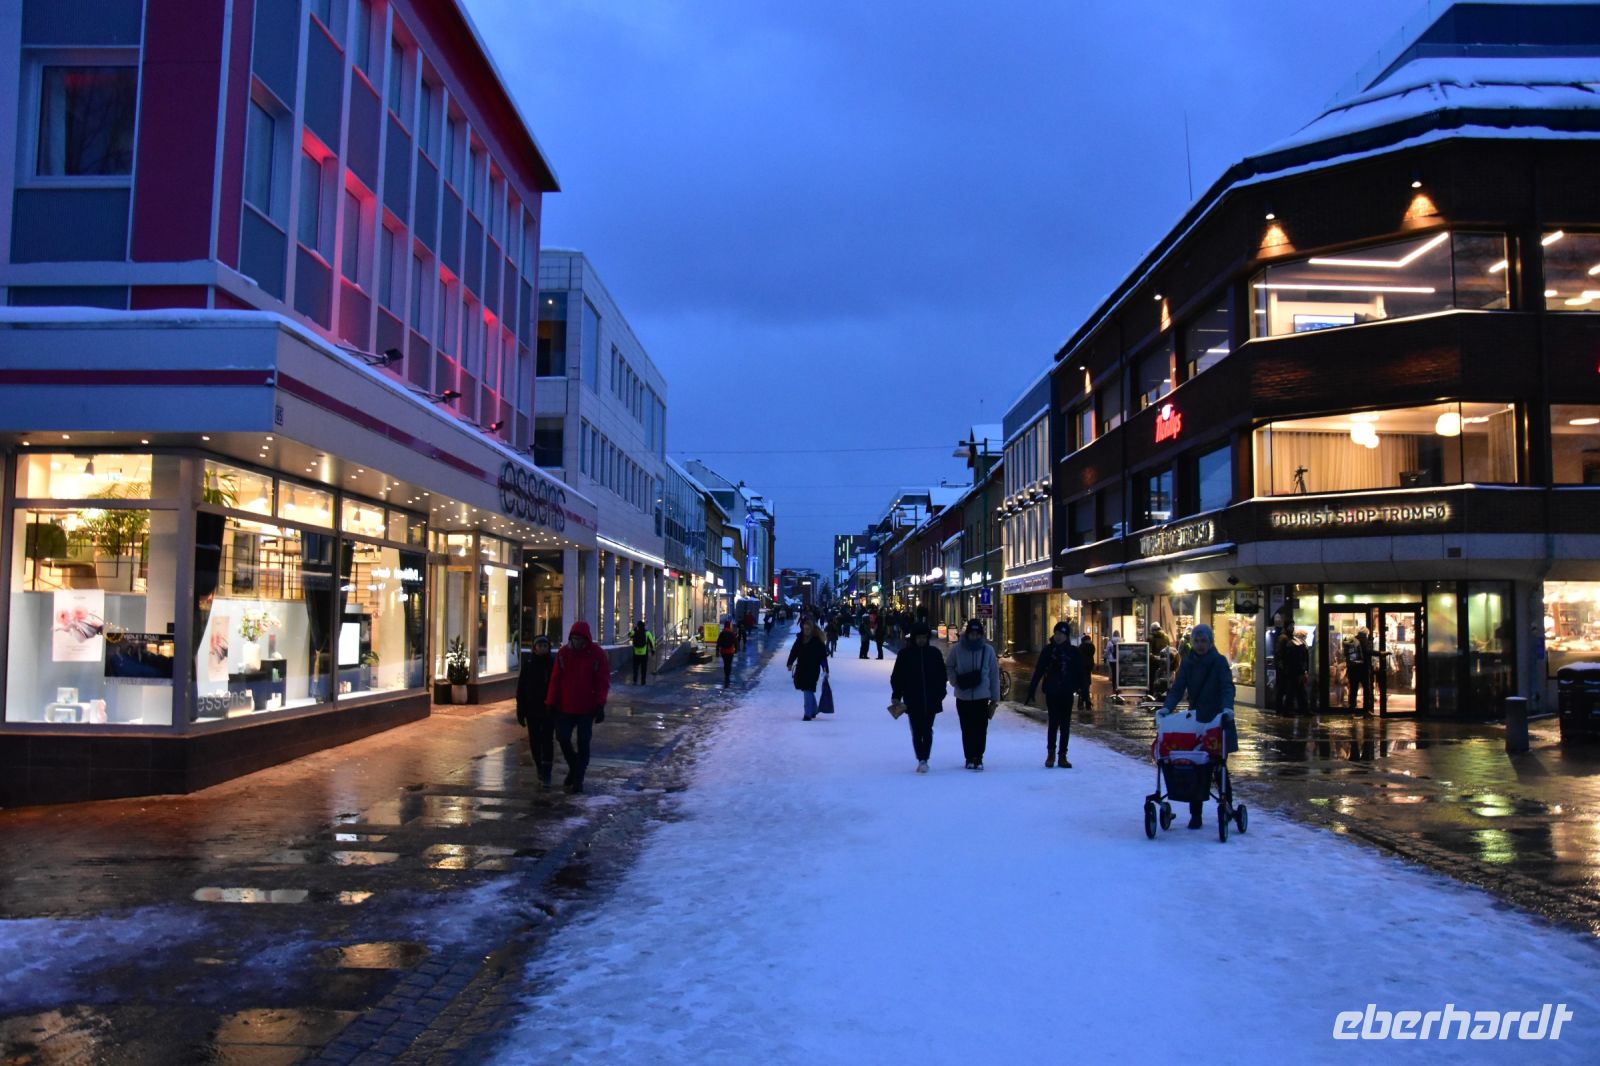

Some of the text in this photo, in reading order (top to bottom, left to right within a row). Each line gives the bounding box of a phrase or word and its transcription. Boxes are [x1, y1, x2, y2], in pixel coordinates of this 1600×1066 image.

[502, 461, 566, 532] essens
[1271, 504, 1447, 527] TOURIST SHOP TROMSØ
[197, 690, 246, 713] essens
